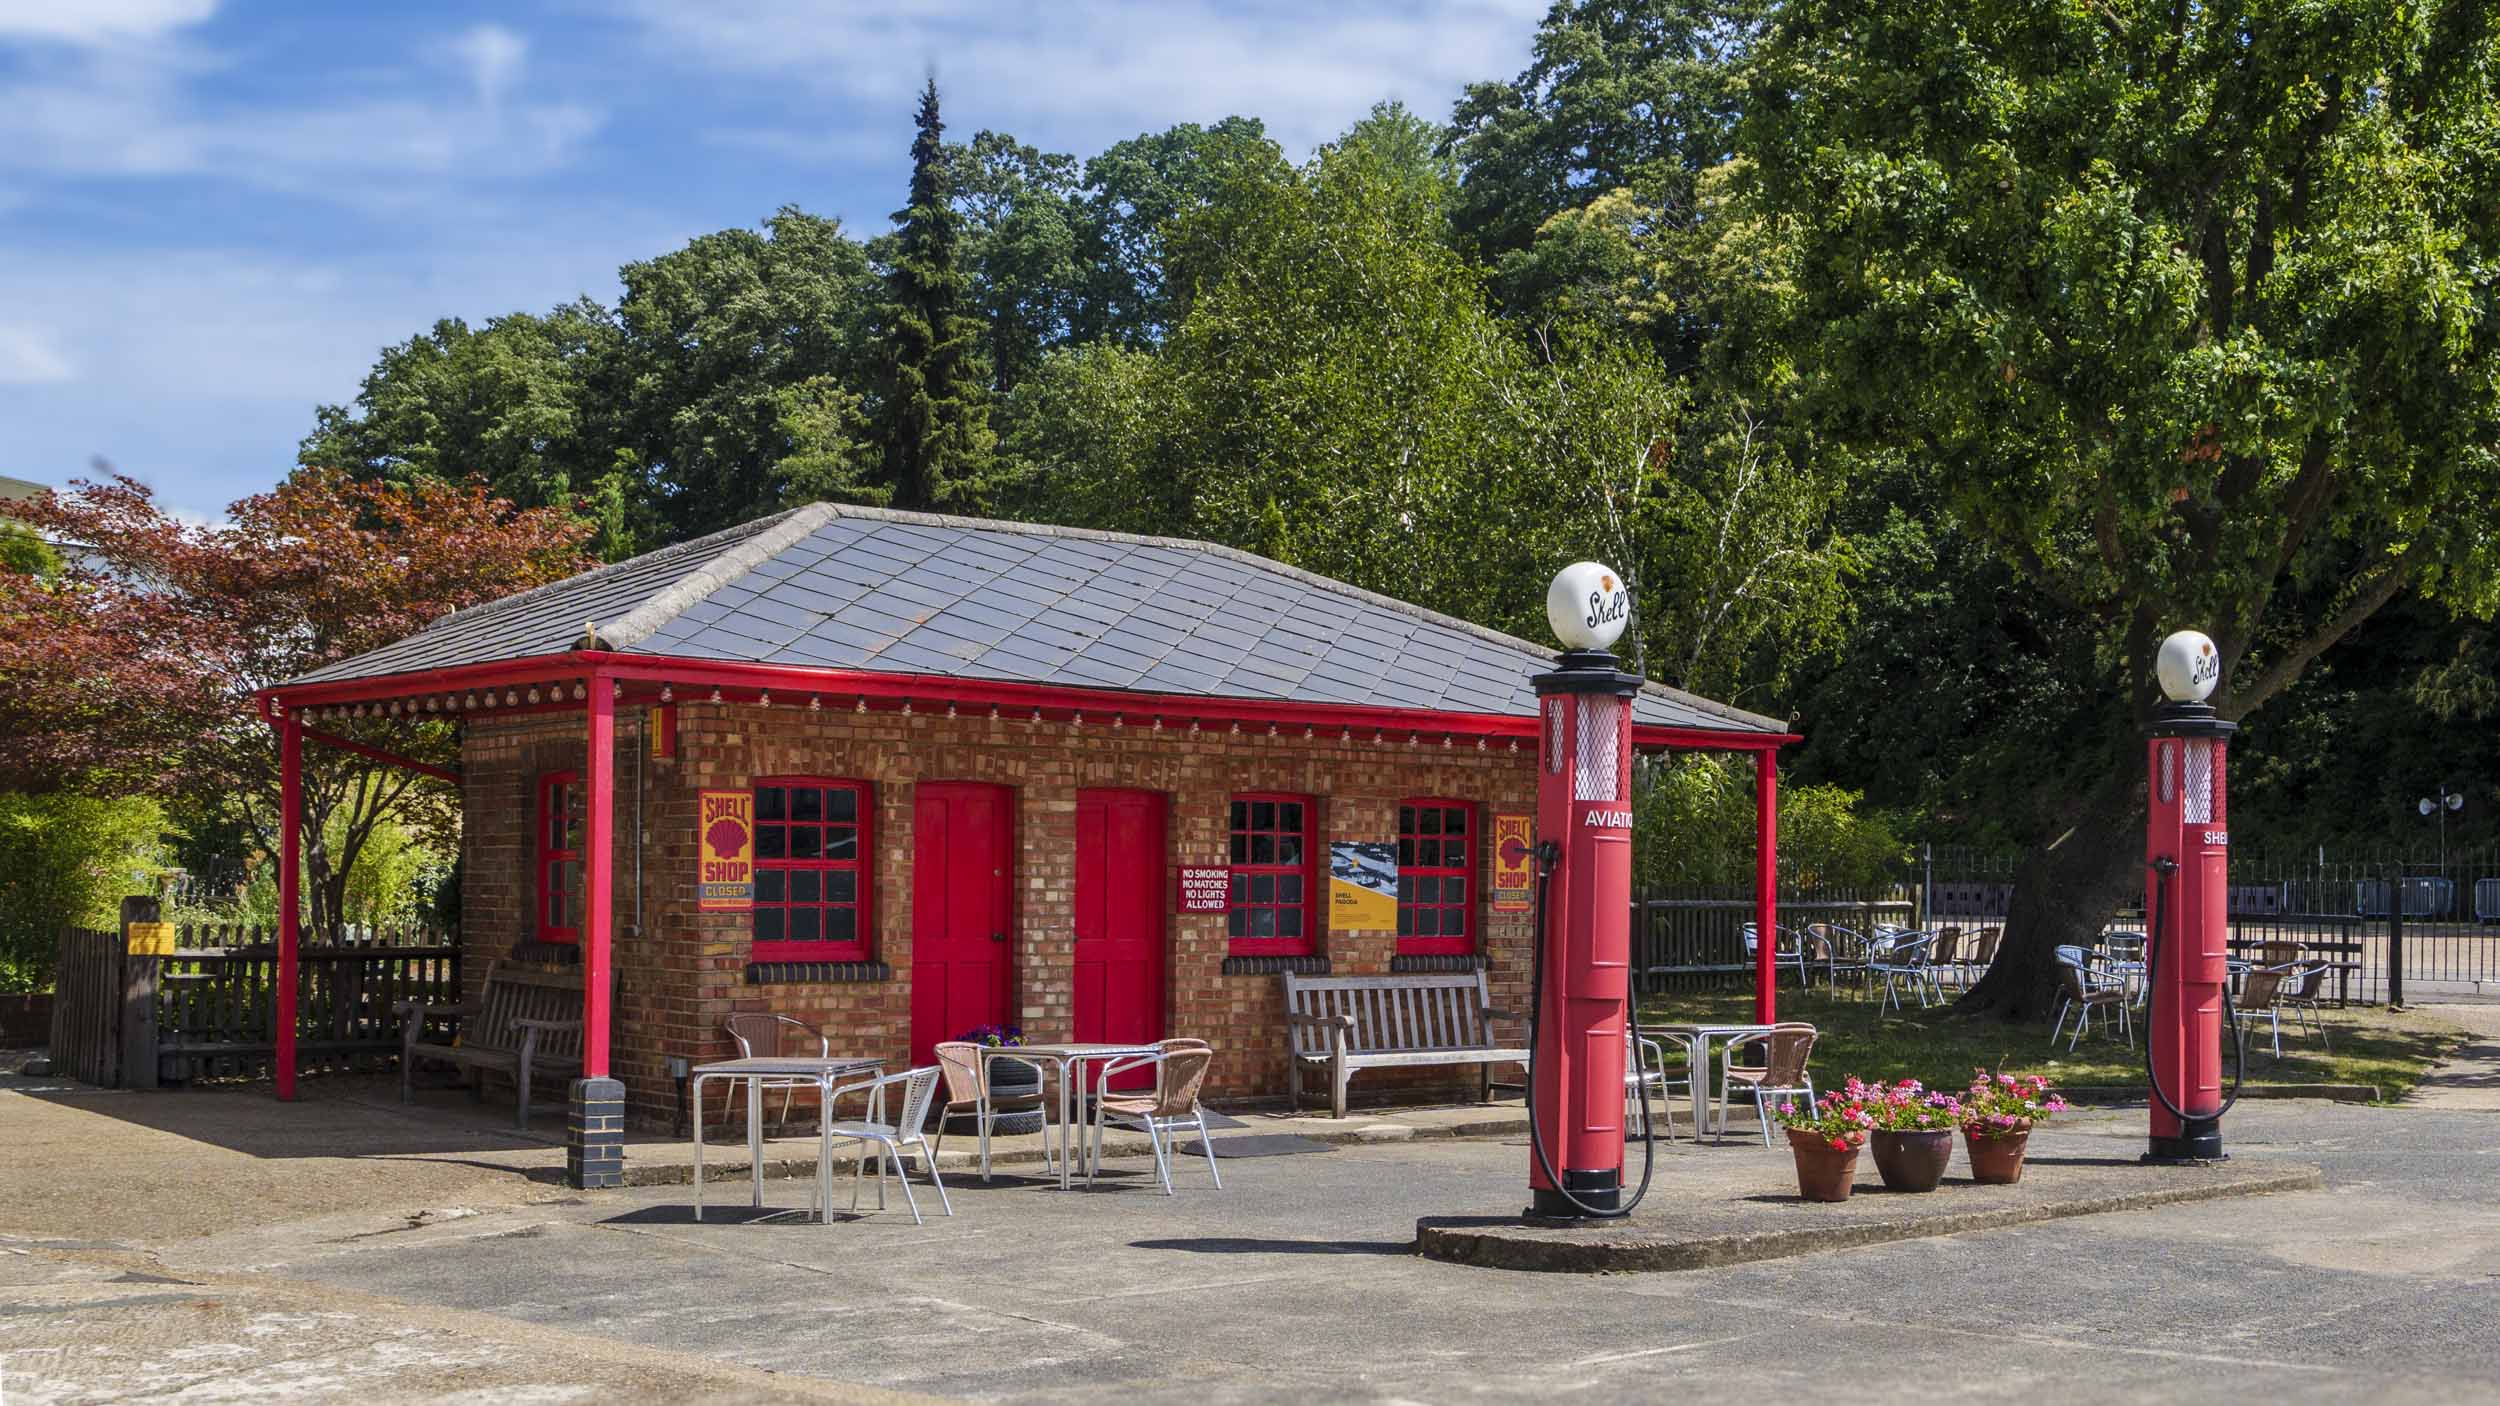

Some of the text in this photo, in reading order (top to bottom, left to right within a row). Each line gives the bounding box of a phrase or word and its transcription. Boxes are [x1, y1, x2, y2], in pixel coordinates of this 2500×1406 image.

[1587, 591, 1626, 629] Shell
[2193, 654, 2217, 685] Shell
[705, 862, 748, 882] SHOP
[1183, 869, 1229, 879] NO SMOKING
[1183, 880, 1228, 889] NO MATCHES
[1498, 872, 1527, 888] SHOP
[705, 886, 746, 897] CLOSED
[1186, 890, 1226, 899] NO LIGHTS
[1186, 900, 1225, 909] ALLOWED
